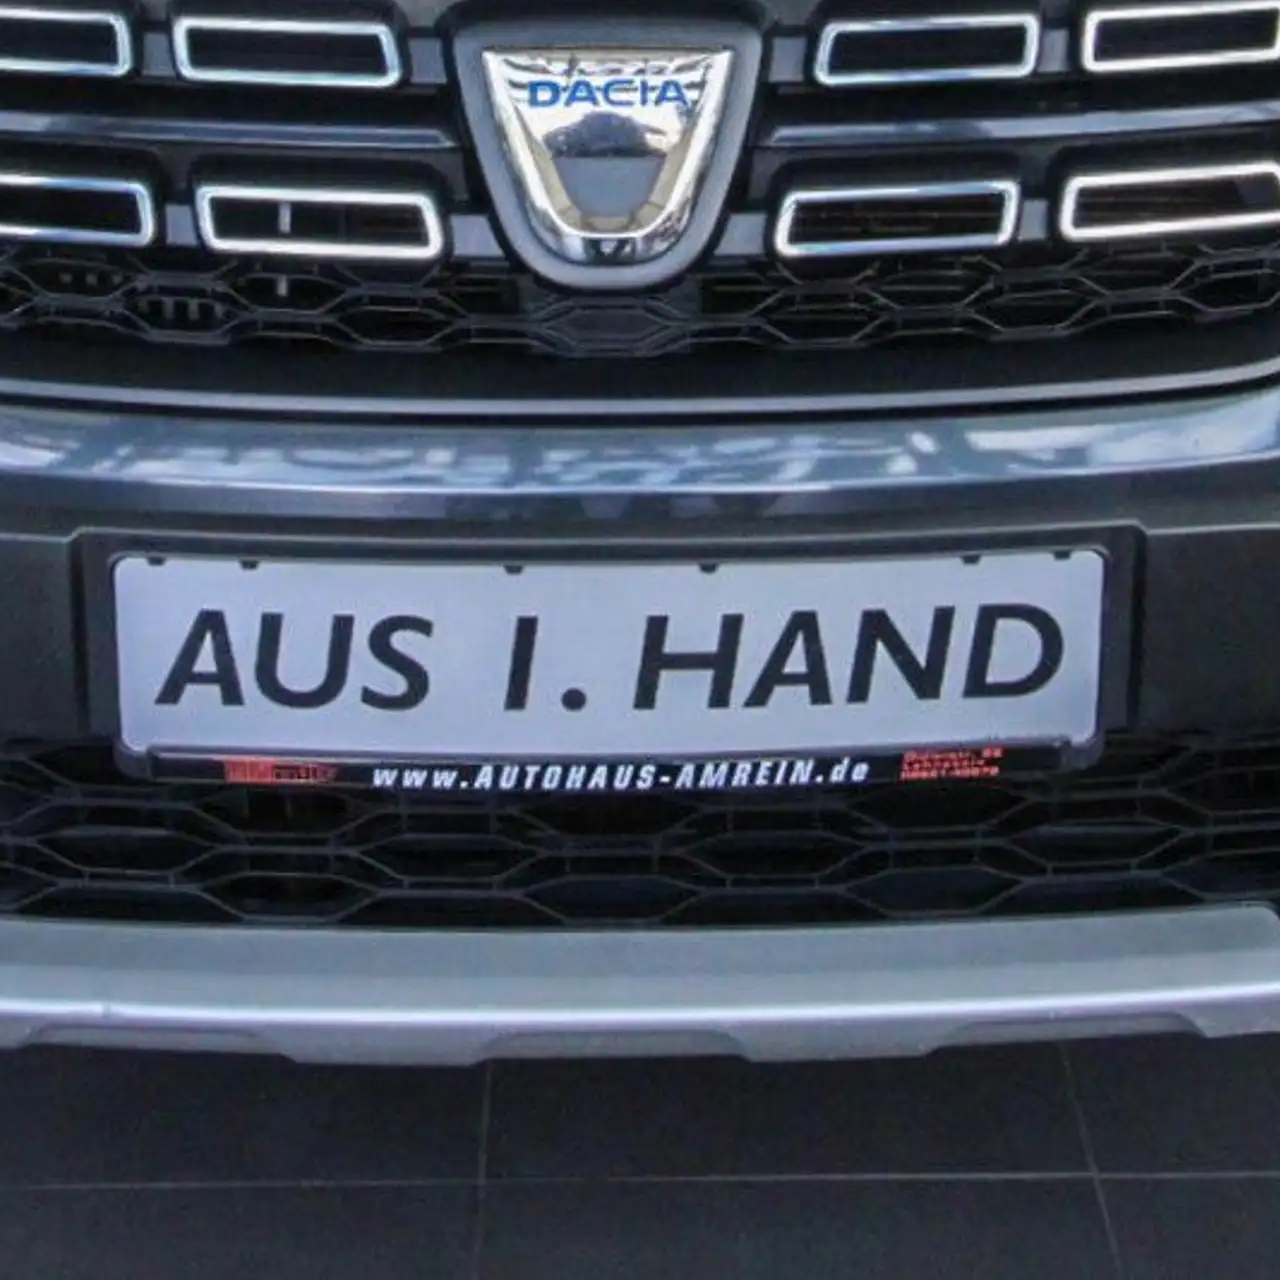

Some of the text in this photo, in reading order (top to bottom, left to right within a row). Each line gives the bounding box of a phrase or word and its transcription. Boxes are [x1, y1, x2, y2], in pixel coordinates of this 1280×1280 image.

[527, 78, 690, 108] DACIA
[154, 603, 1065, 712] AUS I. HAND
[373, 756, 870, 790] www.AUTOHAUS-AMREIN.de
